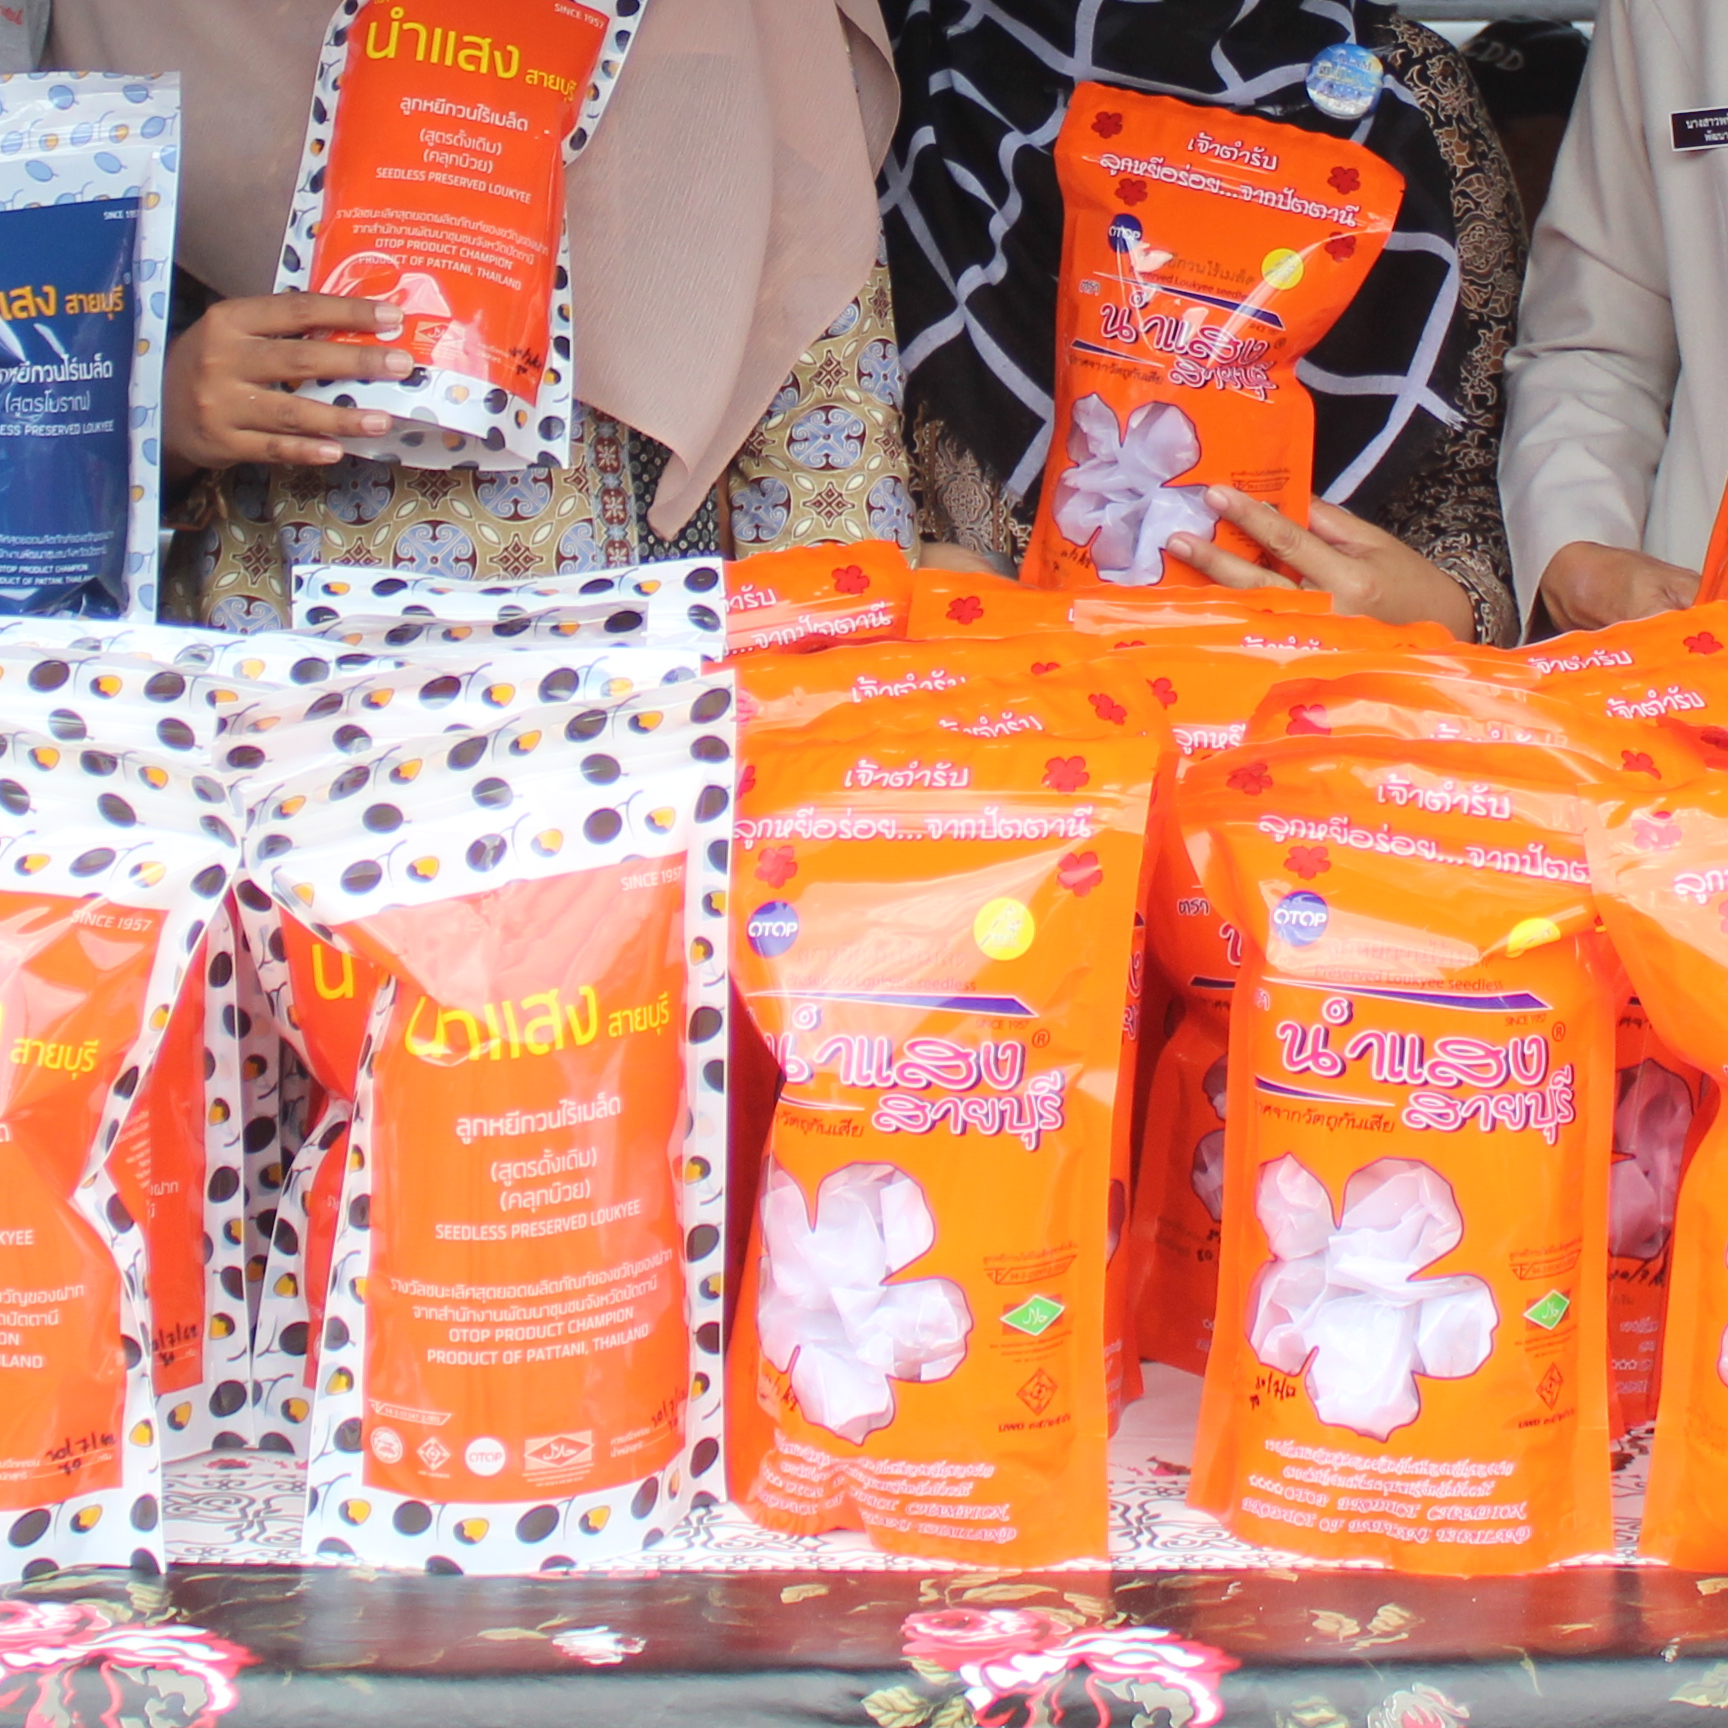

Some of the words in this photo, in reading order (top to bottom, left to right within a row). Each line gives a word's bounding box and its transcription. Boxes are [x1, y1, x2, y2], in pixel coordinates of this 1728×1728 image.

[554, 2, 582, 22] SINCE
[364, 6, 520, 80] นำแสง
[525, 68, 576, 102] สายบุรี
[400, 96, 529, 132] ลูกหยีกวนไร้เมล็ด
[419, 128, 502, 156] (สูตรดั้งเดิม)
[1187, 132, 1278, 172] เจ้าตำรับ
[376, 167, 426, 182] SEEDLESS
[428, 170, 487, 193] PRESERVED
[488, 182, 532, 205] LOUKYEE
[375, 237, 404, 249] OTOP
[407, 239, 457, 255] PRODUCT
[459, 247, 514, 271] CHAMPION
[410, 255, 423, 266] OF
[477, 268, 522, 292] THAILAND
[1100, 288, 1270, 366] นำแสง
[844, 759, 970, 791] เจ้าตำรับ
[1377, 774, 1512, 821] เจ้าตำรับ
[620, 874, 659, 891] SINCE
[70, 909, 116, 928] SINCE
[117, 916, 153, 934] 1957
[1178, 898, 1210, 917] ตรา
[1273, 907, 1328, 928] OTOP
[748, 919, 799, 939] OTOP
[607, 991, 670, 1040] สายบุรี
[9, 1037, 100, 1081] สายบุรี
[1277, 996, 1548, 1089] นำแสง
[455, 1092, 621, 1145] ลูกหยีกวนไร้เมล็ด
[872, 1070, 1065, 1153] สายบุรี
[1402, 1065, 1575, 1146] สายบุรี
[490, 1147, 598, 1187] (สูตรดั้งเดิม)
[435, 1222, 508, 1241] SEEDLESS
[511, 1209, 588, 1239] PRESERVED
[589, 1199, 641, 1226] LOUKYEE
[426, 1348, 499, 1366] PRODUCT
[502, 1348, 522, 1364] OF
[526, 1343, 589, 1363] PATTANI,
[593, 1323, 650, 1352] THAILAND
[448, 1326, 491, 1343] OTOP
[494, 1323, 564, 1343] PRODUCT
[567, 1307, 634, 1335] CHAMPION
